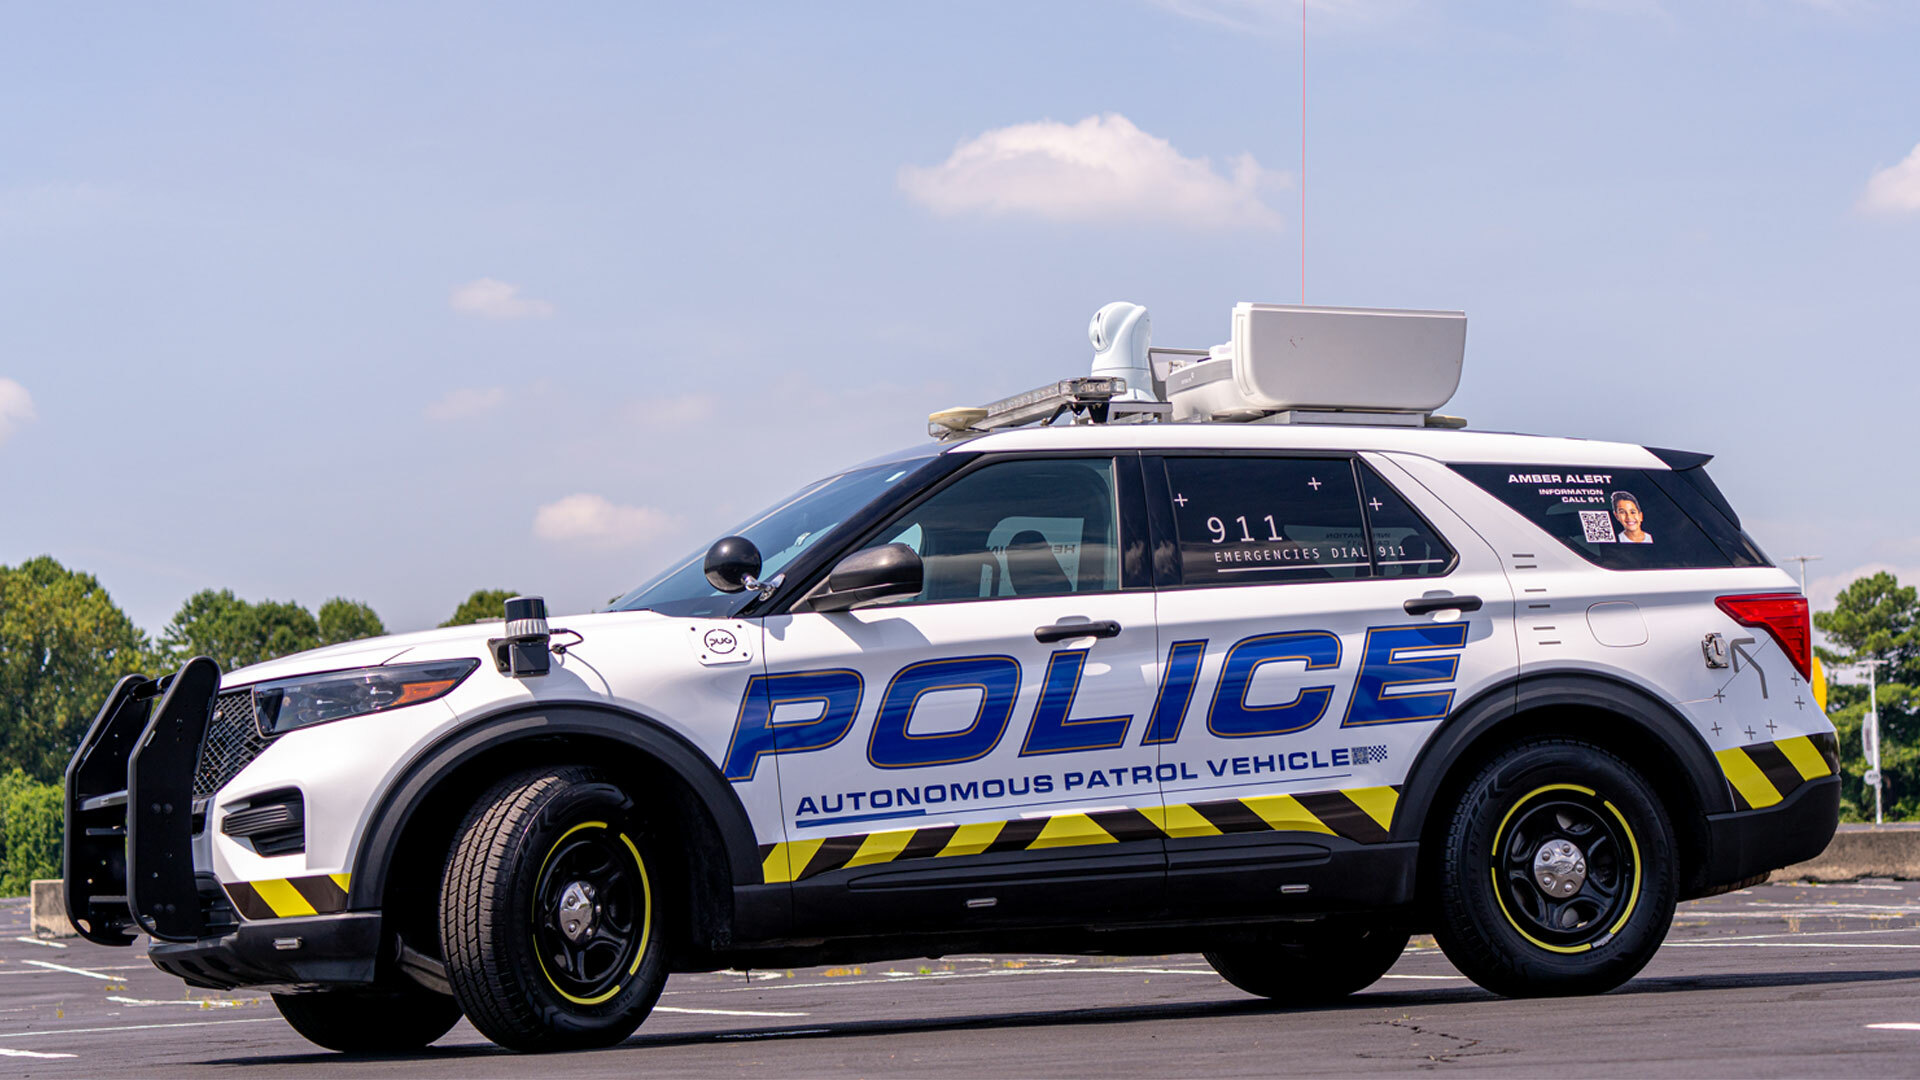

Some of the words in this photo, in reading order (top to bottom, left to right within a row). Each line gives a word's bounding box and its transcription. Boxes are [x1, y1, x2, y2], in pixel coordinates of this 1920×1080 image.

[1508, 474, 1562, 483] AMBER
[1566, 474, 1612, 484] ALERT
[1207, 514, 1283, 543] 911
[1214, 547, 1320, 563] EMERGENCIES
[1331, 547, 1368, 559] DIAL
[1378, 546, 1406, 557] 911
[721, 621, 1469, 781] POLICE
[796, 774, 1054, 816] AUTONOMOUS
[1064, 762, 1198, 791] PATROL
[1206, 748, 1350, 777] VEHICLE
